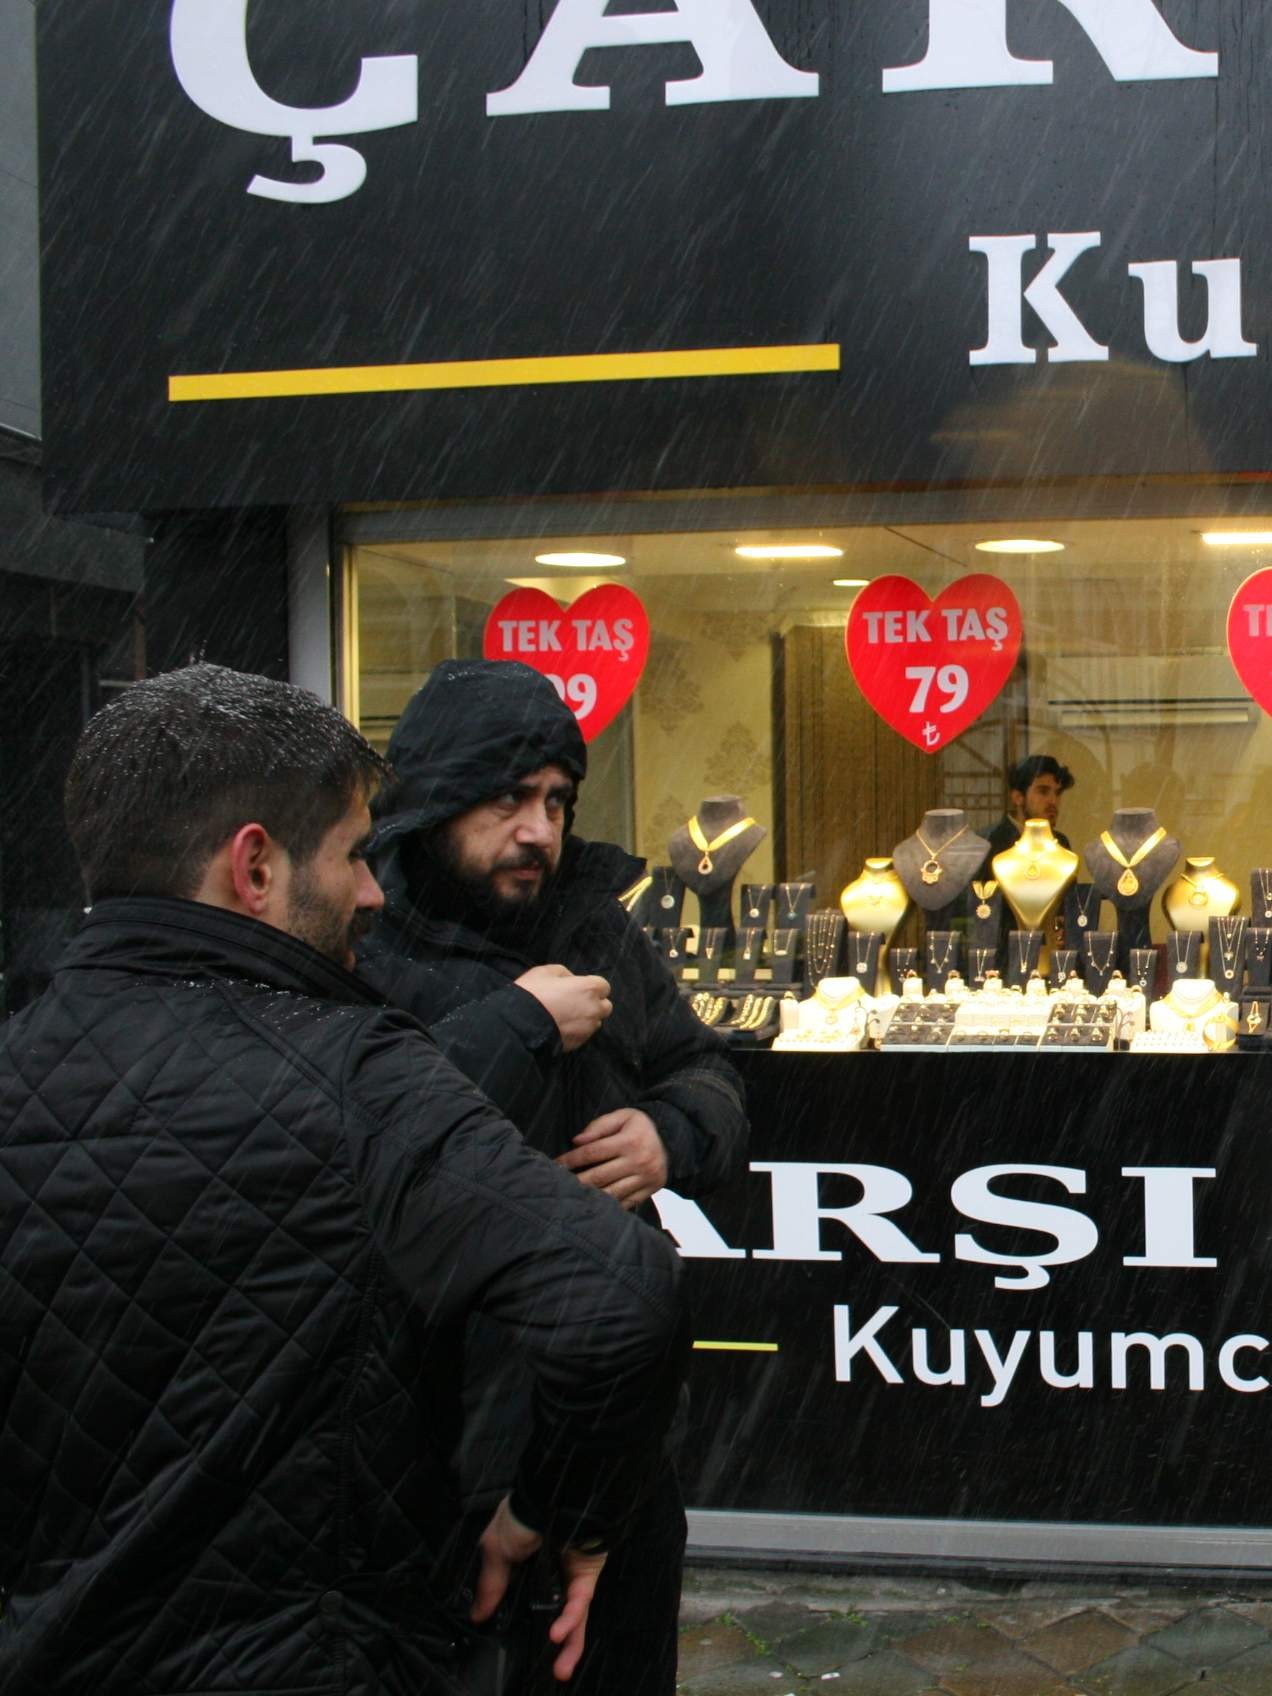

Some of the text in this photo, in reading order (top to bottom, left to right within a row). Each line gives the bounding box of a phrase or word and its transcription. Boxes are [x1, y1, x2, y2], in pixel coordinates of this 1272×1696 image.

[499, 618, 634, 662] TEK TAŞ
[862, 606, 1009, 652] TEK TAŞ
[905, 663, 970, 714] 79
